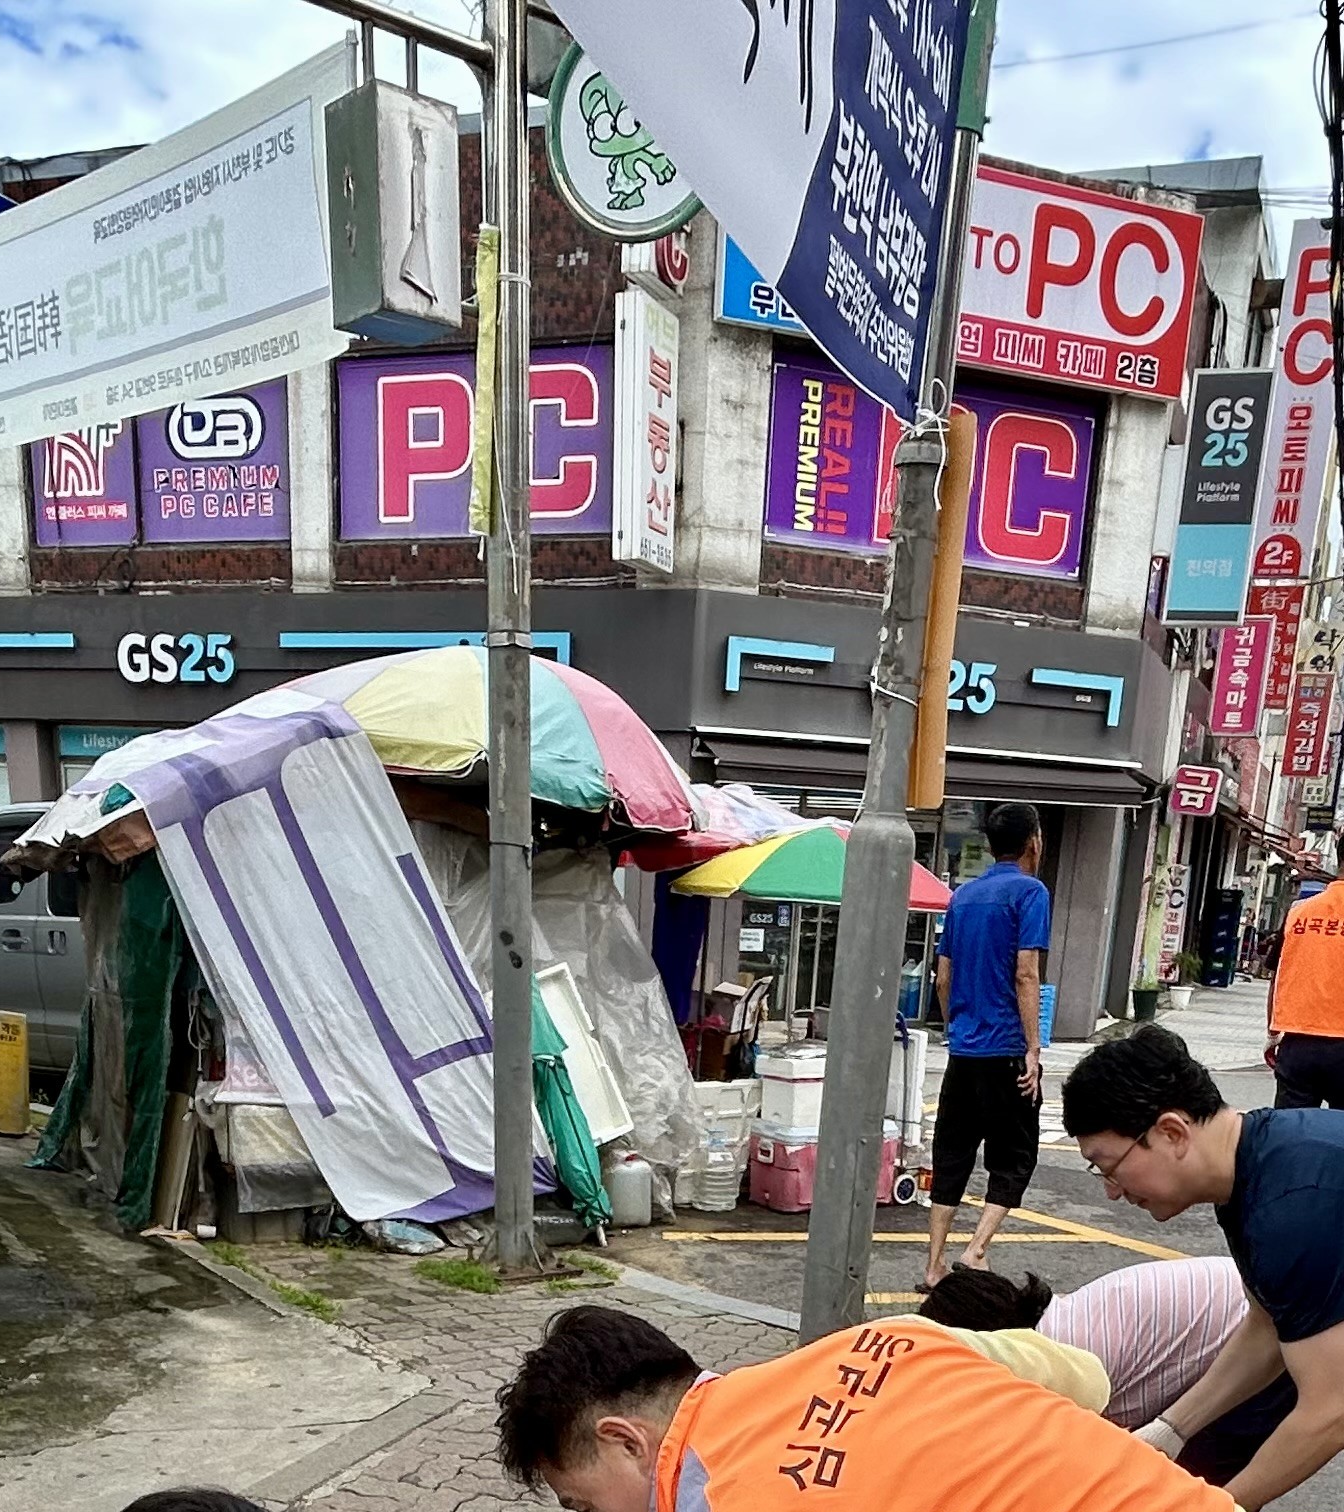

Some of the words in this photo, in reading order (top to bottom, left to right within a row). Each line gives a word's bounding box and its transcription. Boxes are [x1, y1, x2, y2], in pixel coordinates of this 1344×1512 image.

[830, 98, 883, 258] 부천역
[1025, 202, 1171, 338] PC
[993, 328, 1046, 369] 피씨
[1056, 339, 1107, 380] 카페
[1115, 352, 1160, 389] 2층
[646, 345, 673, 538] 부동산
[1204, 396, 1256, 432] GS
[154, 465, 280, 492] PREMIUM
[792, 377, 824, 533] PREMIUM
[814, 383, 857, 537] REAL!!
[1200, 431, 1250, 468] 25
[1270, 403, 1314, 525] 오토피씨
[161, 495, 197, 519] PC
[203, 492, 274, 518] CAFE
[1195, 490, 1241, 503] Platform
[1197, 481, 1242, 496] Lifestyle
[117, 631, 236, 683] GS25
[1220, 626, 1255, 729] 귀금속마트
[1292, 701, 1322, 773] 즉석김밥
[1175, 770, 1214, 811] 금
[778, 1328, 916, 1493] 심곡본동
